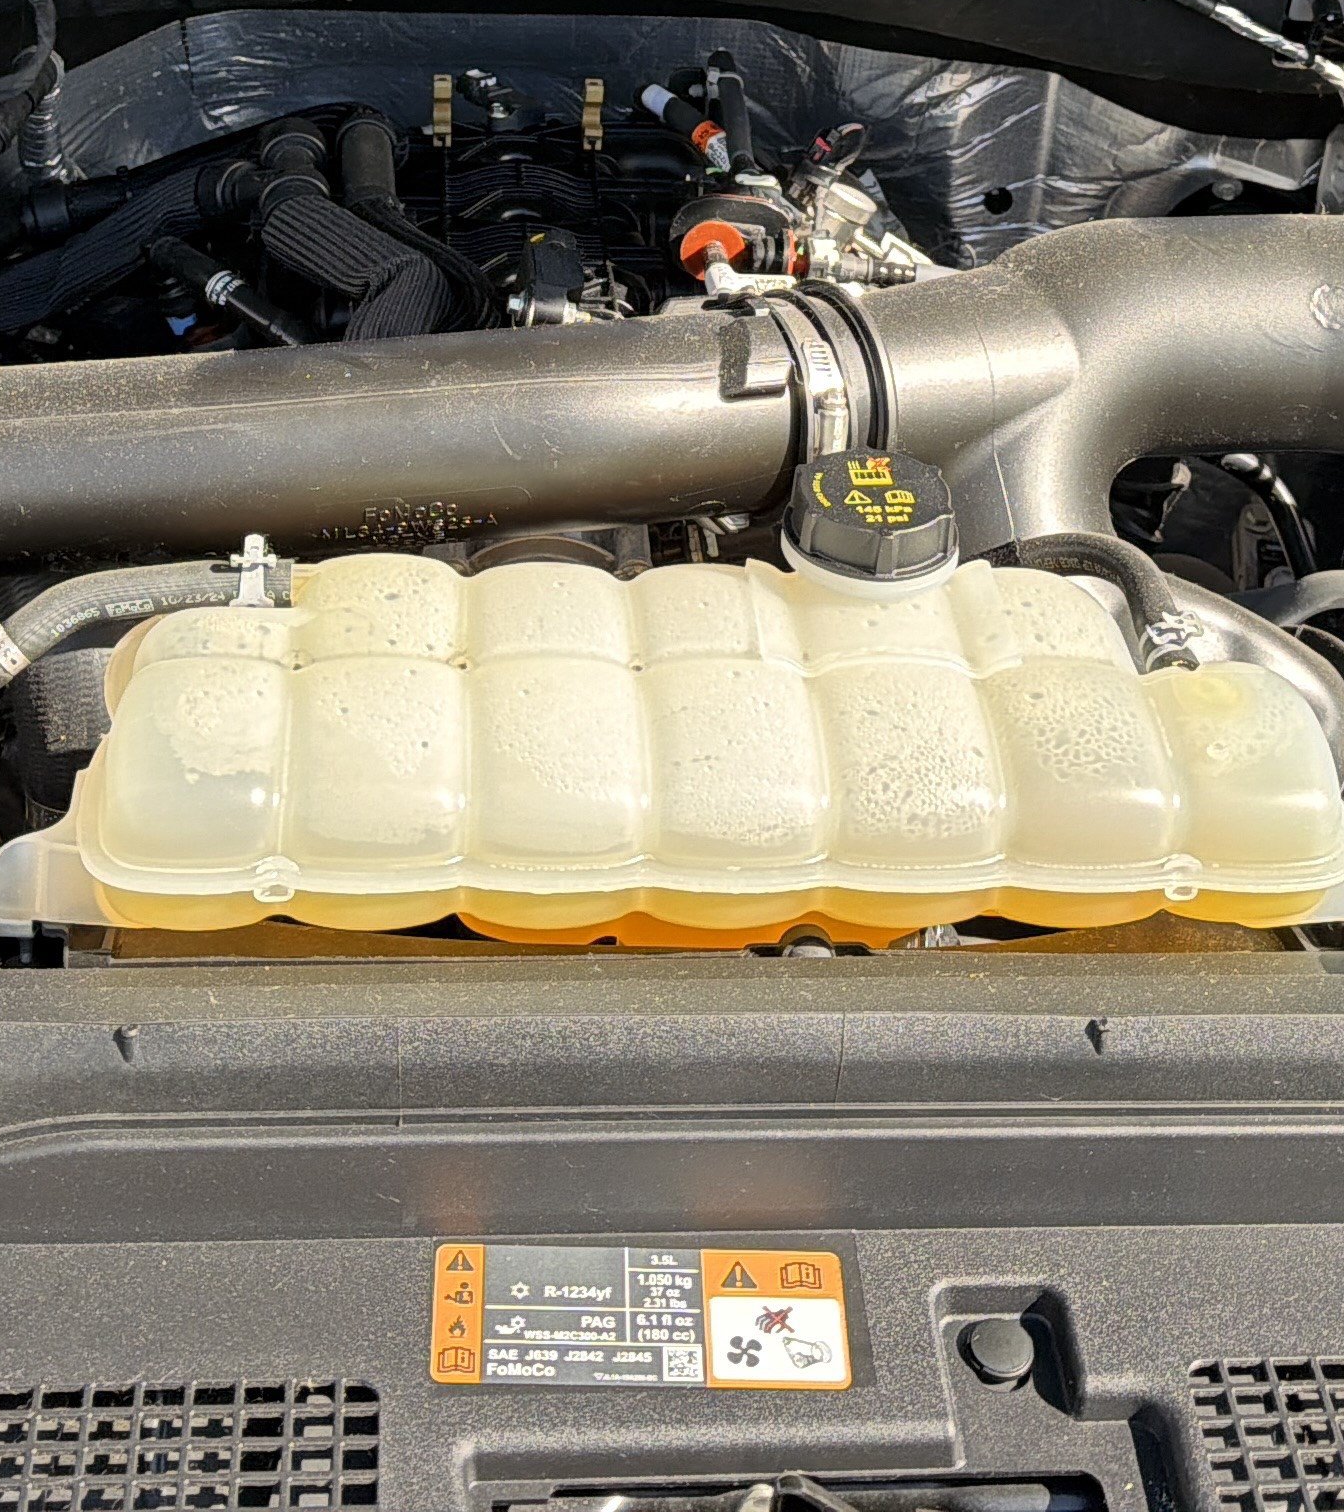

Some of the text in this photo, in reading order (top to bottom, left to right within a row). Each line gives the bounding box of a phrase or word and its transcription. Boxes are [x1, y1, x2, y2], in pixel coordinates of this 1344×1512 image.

[865, 514, 909, 524] 21 psi
[650, 1255, 678, 1265] 3.5L
[637, 1274, 692, 1289] 1.050 kg
[543, 1285, 612, 1301] R-1234yf
[650, 1288, 680, 1297] 37 oz
[670, 1299, 687, 1308] lbs
[580, 1316, 616, 1329] PAG
[637, 1315, 694, 1327] 6.1 fl oz
[637, 1328, 695, 1343] (180 cc)
[488, 1349, 519, 1360] SAE
[524, 1349, 558, 1361] J639
[564, 1350, 604, 1362] J2842
[487, 1363, 556, 1377] FoMoCo
